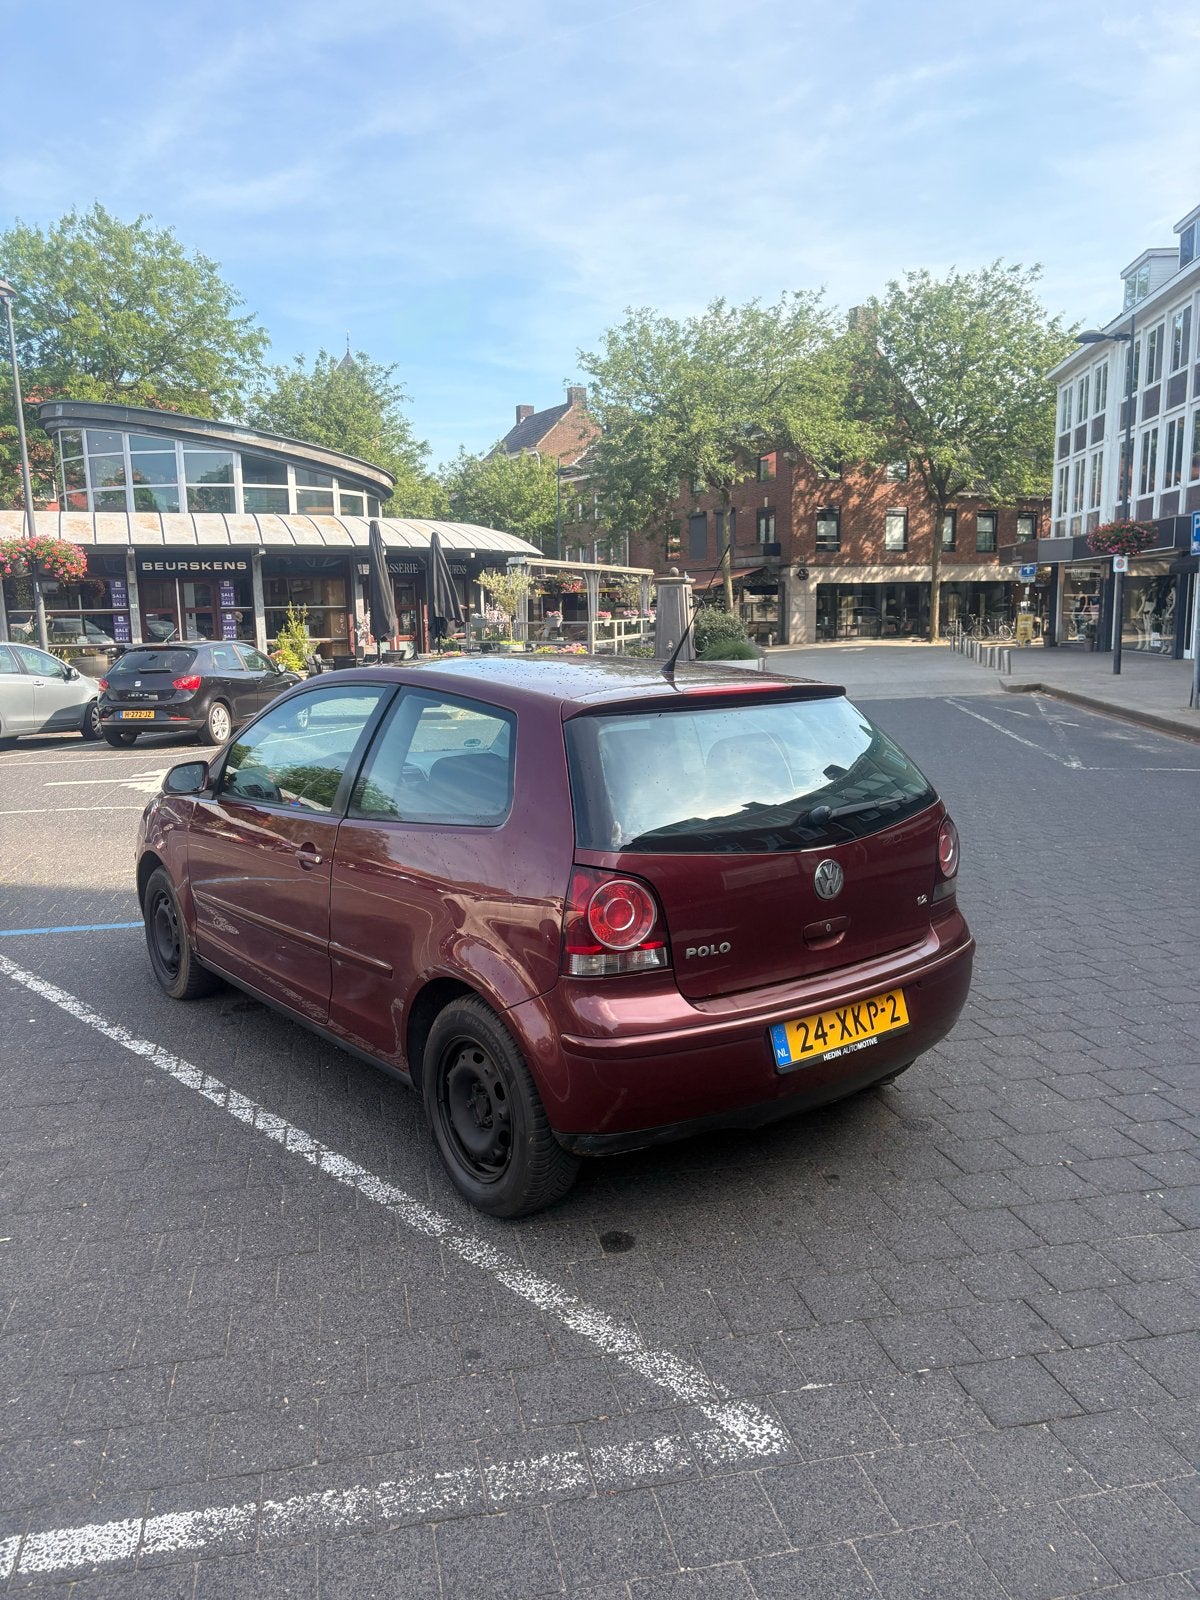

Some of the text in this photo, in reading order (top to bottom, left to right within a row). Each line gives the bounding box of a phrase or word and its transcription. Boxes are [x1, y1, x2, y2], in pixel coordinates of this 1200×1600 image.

[142, 562, 247, 570] BEURSKENS
[385, 563, 418, 573] ASSERIE
[685, 941, 731, 960] POLO
[796, 994, 901, 1053] 24-XKP-2
[777, 1049, 789, 1058] NL
[823, 1036, 878, 1061] HEDIN AUTOMOTIVE
